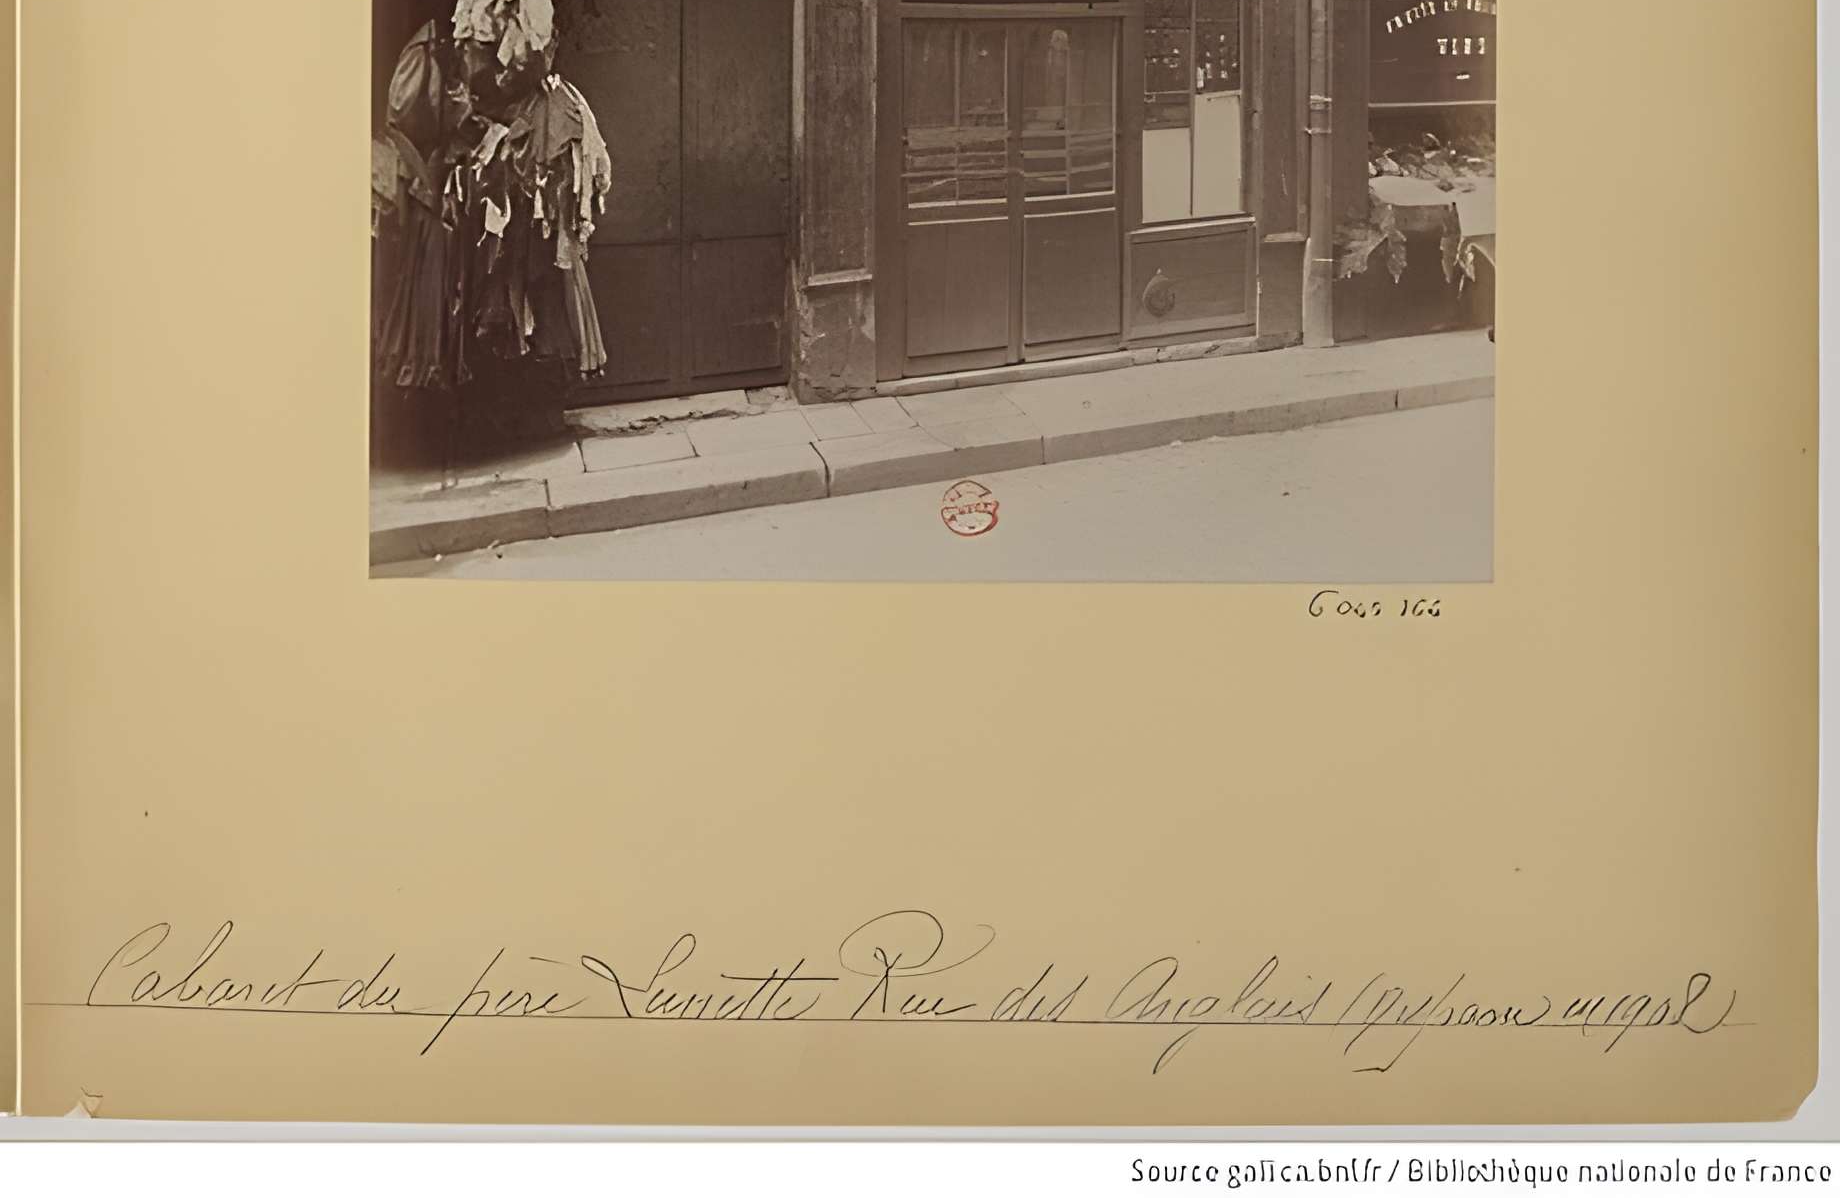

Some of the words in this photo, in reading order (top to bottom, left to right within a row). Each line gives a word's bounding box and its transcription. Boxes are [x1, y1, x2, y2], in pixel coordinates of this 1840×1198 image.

[87, 920, 340, 1008] Cabaret
[337, 953, 434, 1014] du
[838, 910, 996, 1020] Rue
[989, 963, 1089, 1023] des
[1105, 955, 1333, 1075] Anglais
